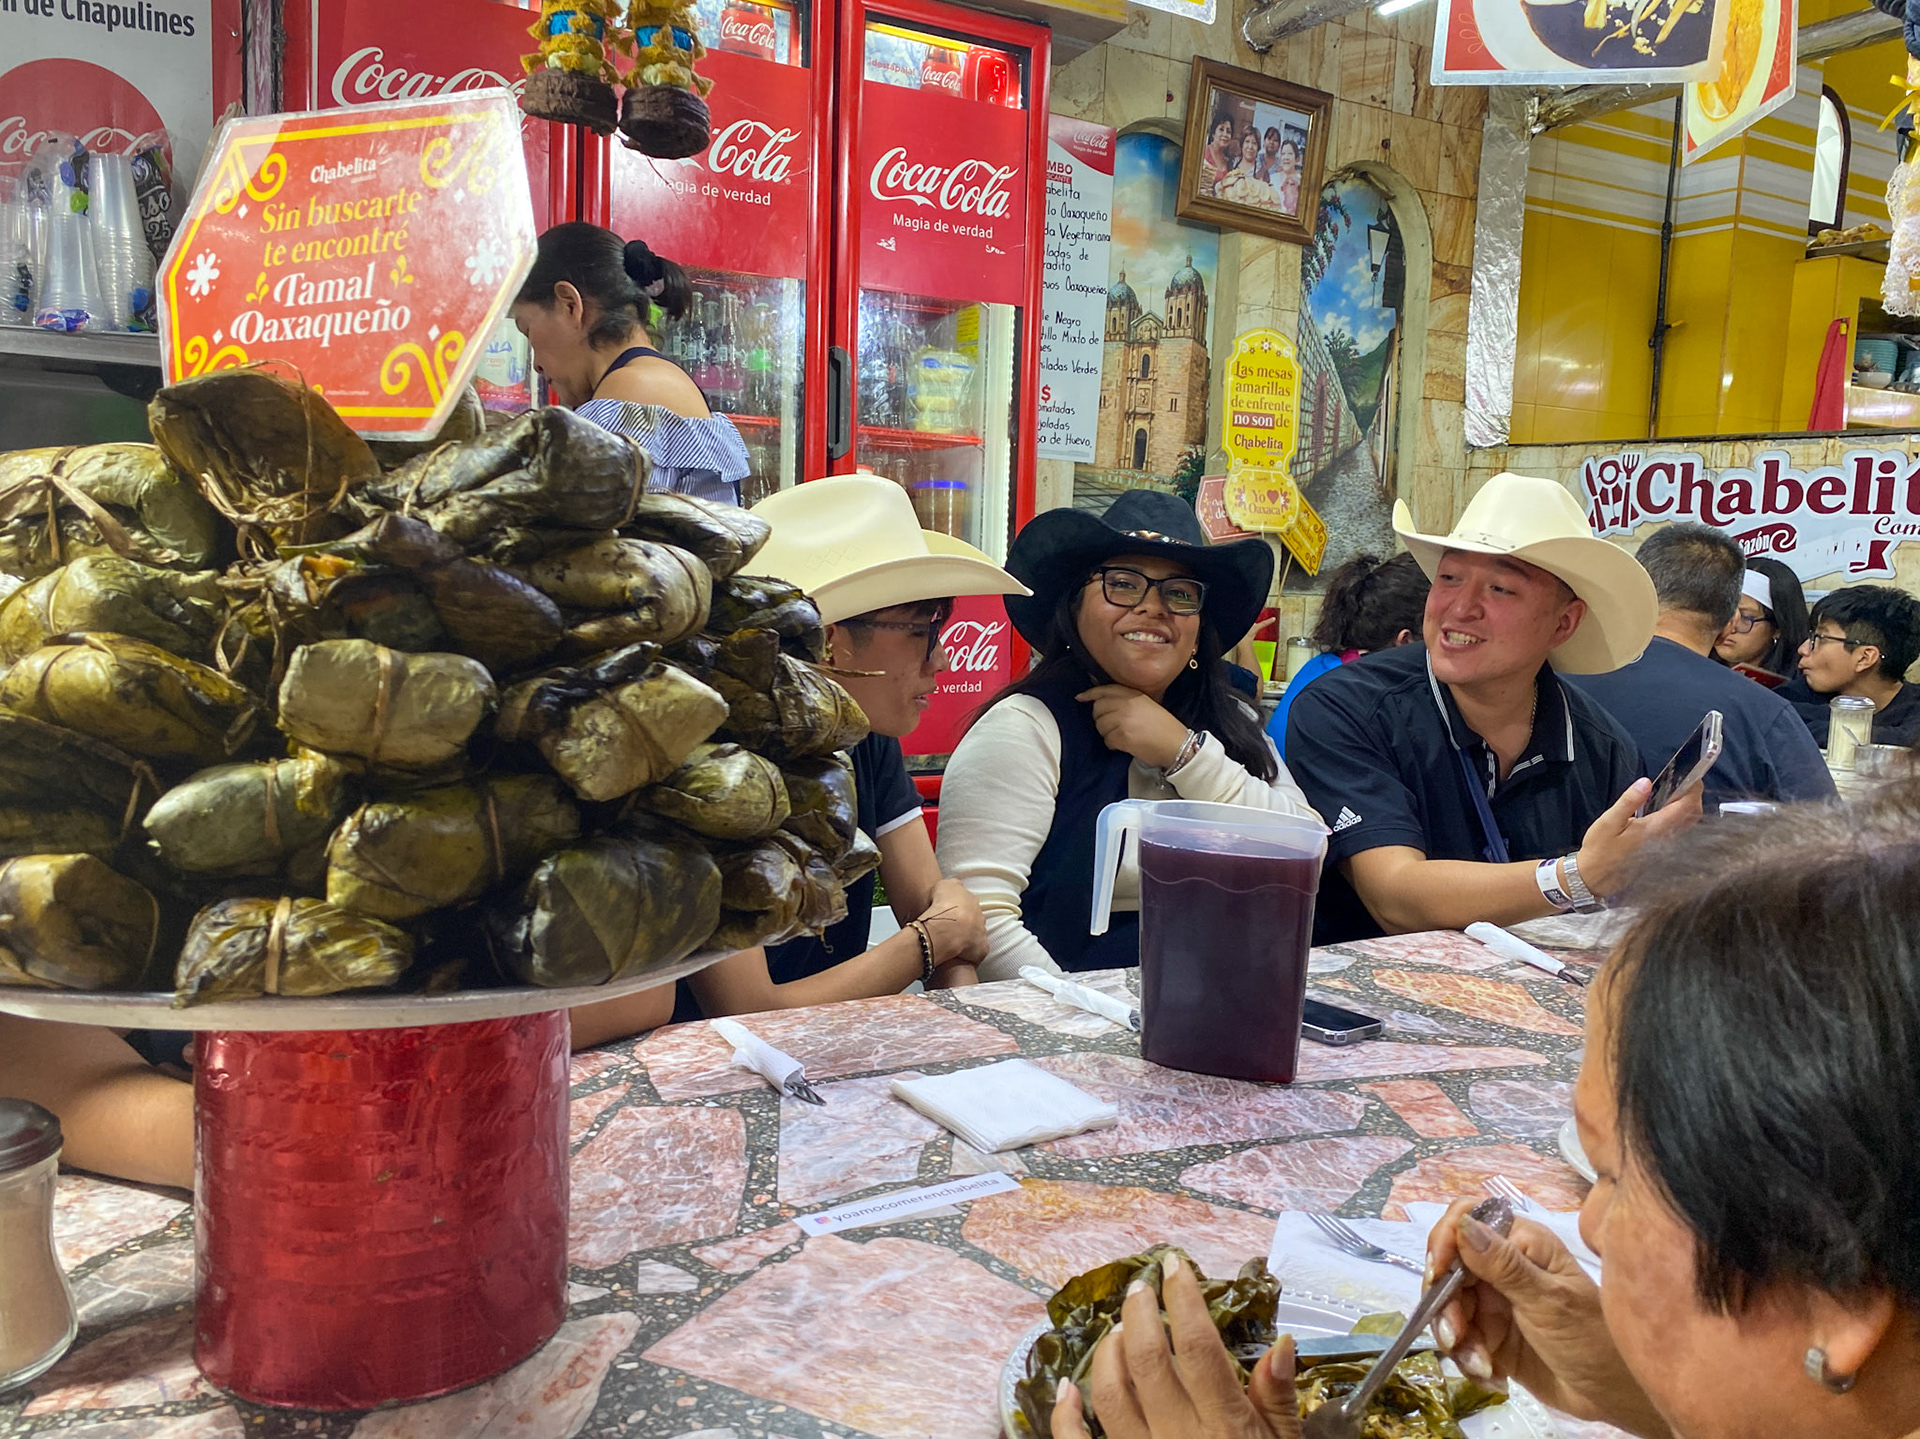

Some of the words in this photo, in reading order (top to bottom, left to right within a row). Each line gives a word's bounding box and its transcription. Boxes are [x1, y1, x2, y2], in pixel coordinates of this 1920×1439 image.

[61, 0, 195, 37] Chapulines
[721, 16, 776, 49] Coca-Cola
[331, 47, 537, 109] Coca-
[922, 66, 961, 92] Coca-Cola
[1073, 131, 1110, 149] Coca-Cola
[310, 157, 377, 184] Chabelita
[654, 176, 697, 195] Magia
[701, 182, 719, 198] de
[723, 187, 771, 206] verdad
[869, 147, 1020, 218] Coca-Cola
[260, 202, 301, 234] Sin
[306, 187, 423, 227] buscarte
[149, 221, 171, 241] 25
[893, 213, 930, 232] Magia
[933, 219, 950, 233] de
[952, 224, 993, 239] verdad
[1059, 222, 1111, 246] Vegetariana
[263, 240, 287, 268] te
[291, 219, 410, 264] encontré
[1079, 247, 1089, 261] de
[273, 261, 376, 308] Tamal
[230, 298, 411, 347] Oaxaqueño
[1055, 310, 1081, 328] Negro
[1062, 330, 1087, 344] Mixto
[1088, 330, 1099, 345] de
[1071, 359, 1098, 374] Verdes
[1235, 361, 1254, 379] Las
[1257, 366, 1293, 380] mesas
[1041, 384, 1051, 404] $
[1235, 381, 1291, 397] amarillas
[1231, 395, 1244, 408] de
[1246, 397, 1294, 413] enfrente,
[1234, 414, 1250, 425] no
[1251, 415, 1273, 427] son
[1275, 414, 1290, 428] de
[1050, 432, 1061, 445] de
[1234, 434, 1283, 450] Chabelita
[1252, 490, 1266, 503] Yo
[1249, 503, 1282, 516] Oaxaca
[942, 680, 982, 694] verdad
[1333, 814, 1363, 832] adidas
[833, 1178, 1000, 1223] yoamocomerenchabelita
